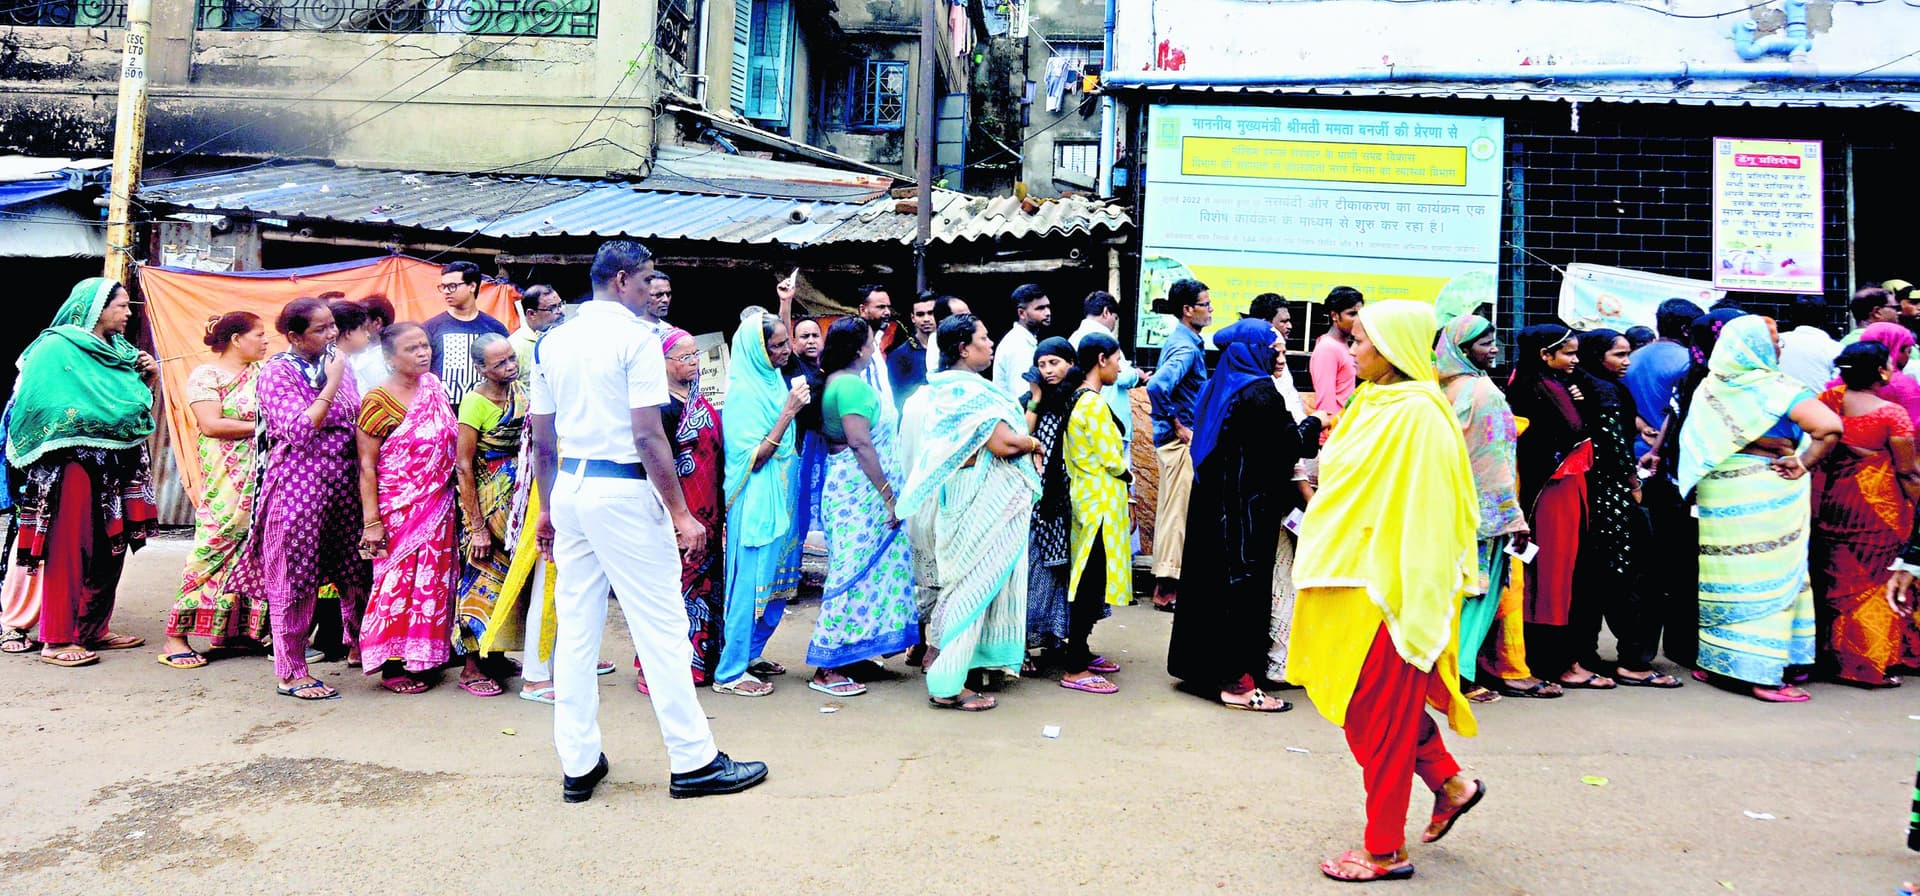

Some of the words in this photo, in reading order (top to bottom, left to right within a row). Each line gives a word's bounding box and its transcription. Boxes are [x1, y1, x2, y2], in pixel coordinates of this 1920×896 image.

[128, 45, 144, 56] LTD
[129, 57, 136, 66] 2
[1192, 114, 1232, 131] माननीय
[1237, 117, 1282, 135] मुख्यमंत्री
[1287, 118, 1320, 134] श्रीमती
[1325, 123, 1353, 136] ममता
[1359, 121, 1389, 137] बनर्जी
[1394, 121, 1409, 137] की
[1414, 122, 1443, 139] प्रेरणा
[1448, 123, 1458, 139] से
[1182, 196, 1200, 204] 2022
[1307, 196, 1329, 209] और
[1335, 196, 1390, 212] टीकाकरण
[1396, 201, 1410, 213] का
[1416, 199, 1460, 215] कार्यक्रम
[1466, 205, 1485, 217] एक
[1200, 208, 1229, 223] विशेष
[1300, 217, 1332, 228] माध्यम
[1339, 215, 1349, 229] से
[1381, 220, 1398, 231] कर
[1405, 221, 1423, 233] रहा
